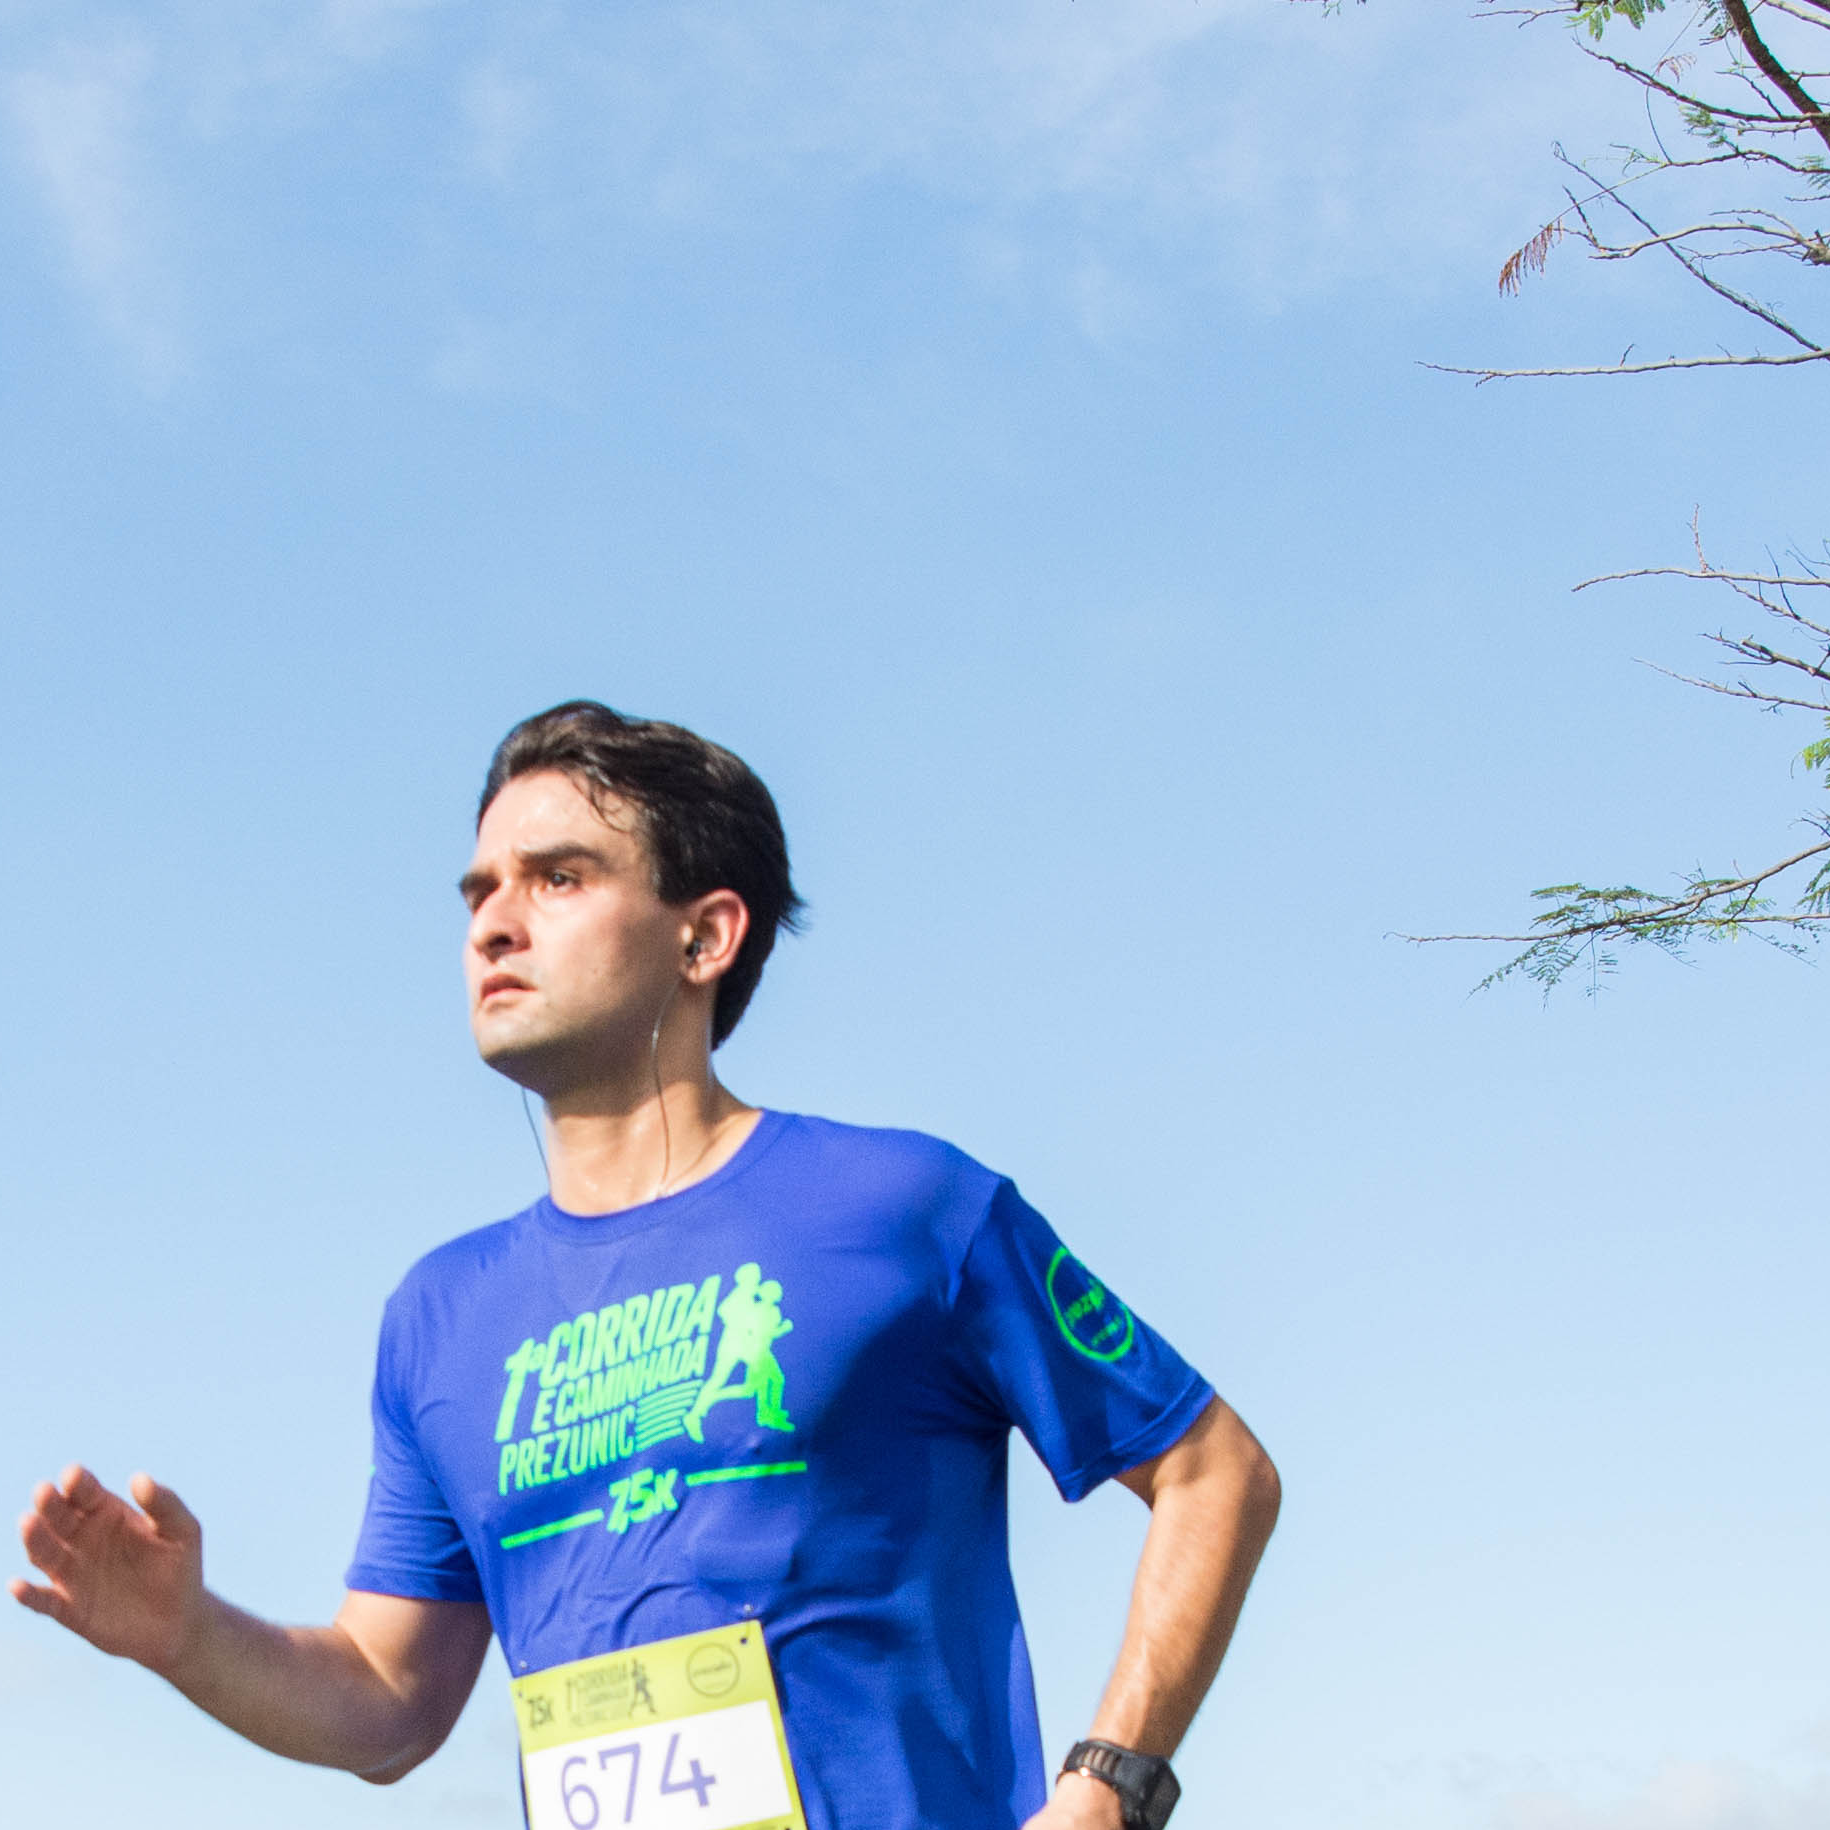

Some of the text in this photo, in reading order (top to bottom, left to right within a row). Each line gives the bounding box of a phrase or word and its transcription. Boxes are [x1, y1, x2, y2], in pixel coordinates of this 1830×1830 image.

[539, 1275, 721, 1389] CORRIDA
[531, 1334, 709, 1433] E CAMINHADA
[498, 1405, 635, 1496] PREZUNIC
